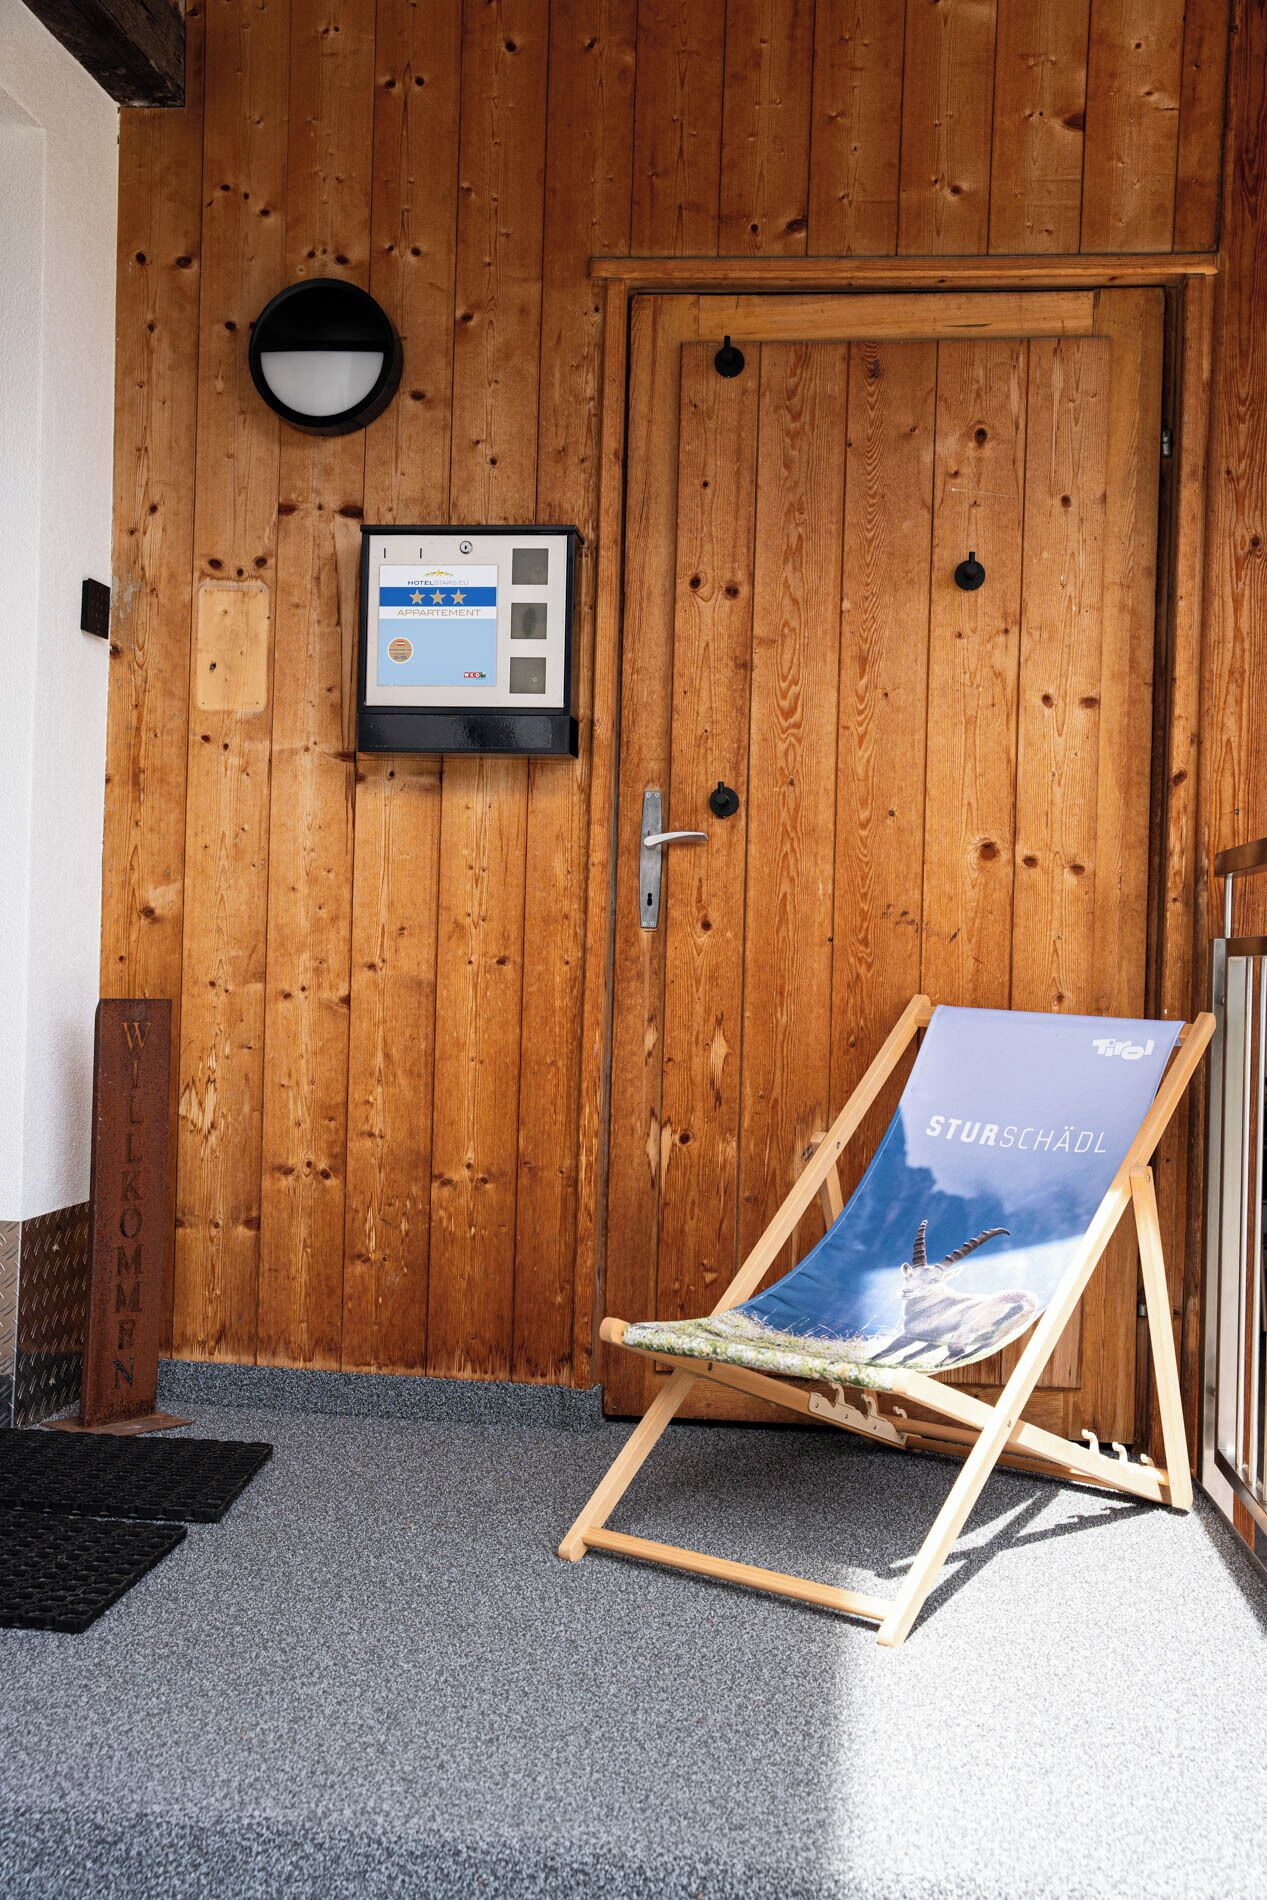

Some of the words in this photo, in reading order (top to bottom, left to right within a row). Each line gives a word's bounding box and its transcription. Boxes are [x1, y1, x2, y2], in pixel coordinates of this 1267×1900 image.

[397, 608, 480, 617] APPARTEMENT
[1092, 1039, 1155, 1060] Tirol
[926, 1115, 1107, 1154] STURSCHÄDL
[112, 1022, 151, 1390] WILLKOMMEN
